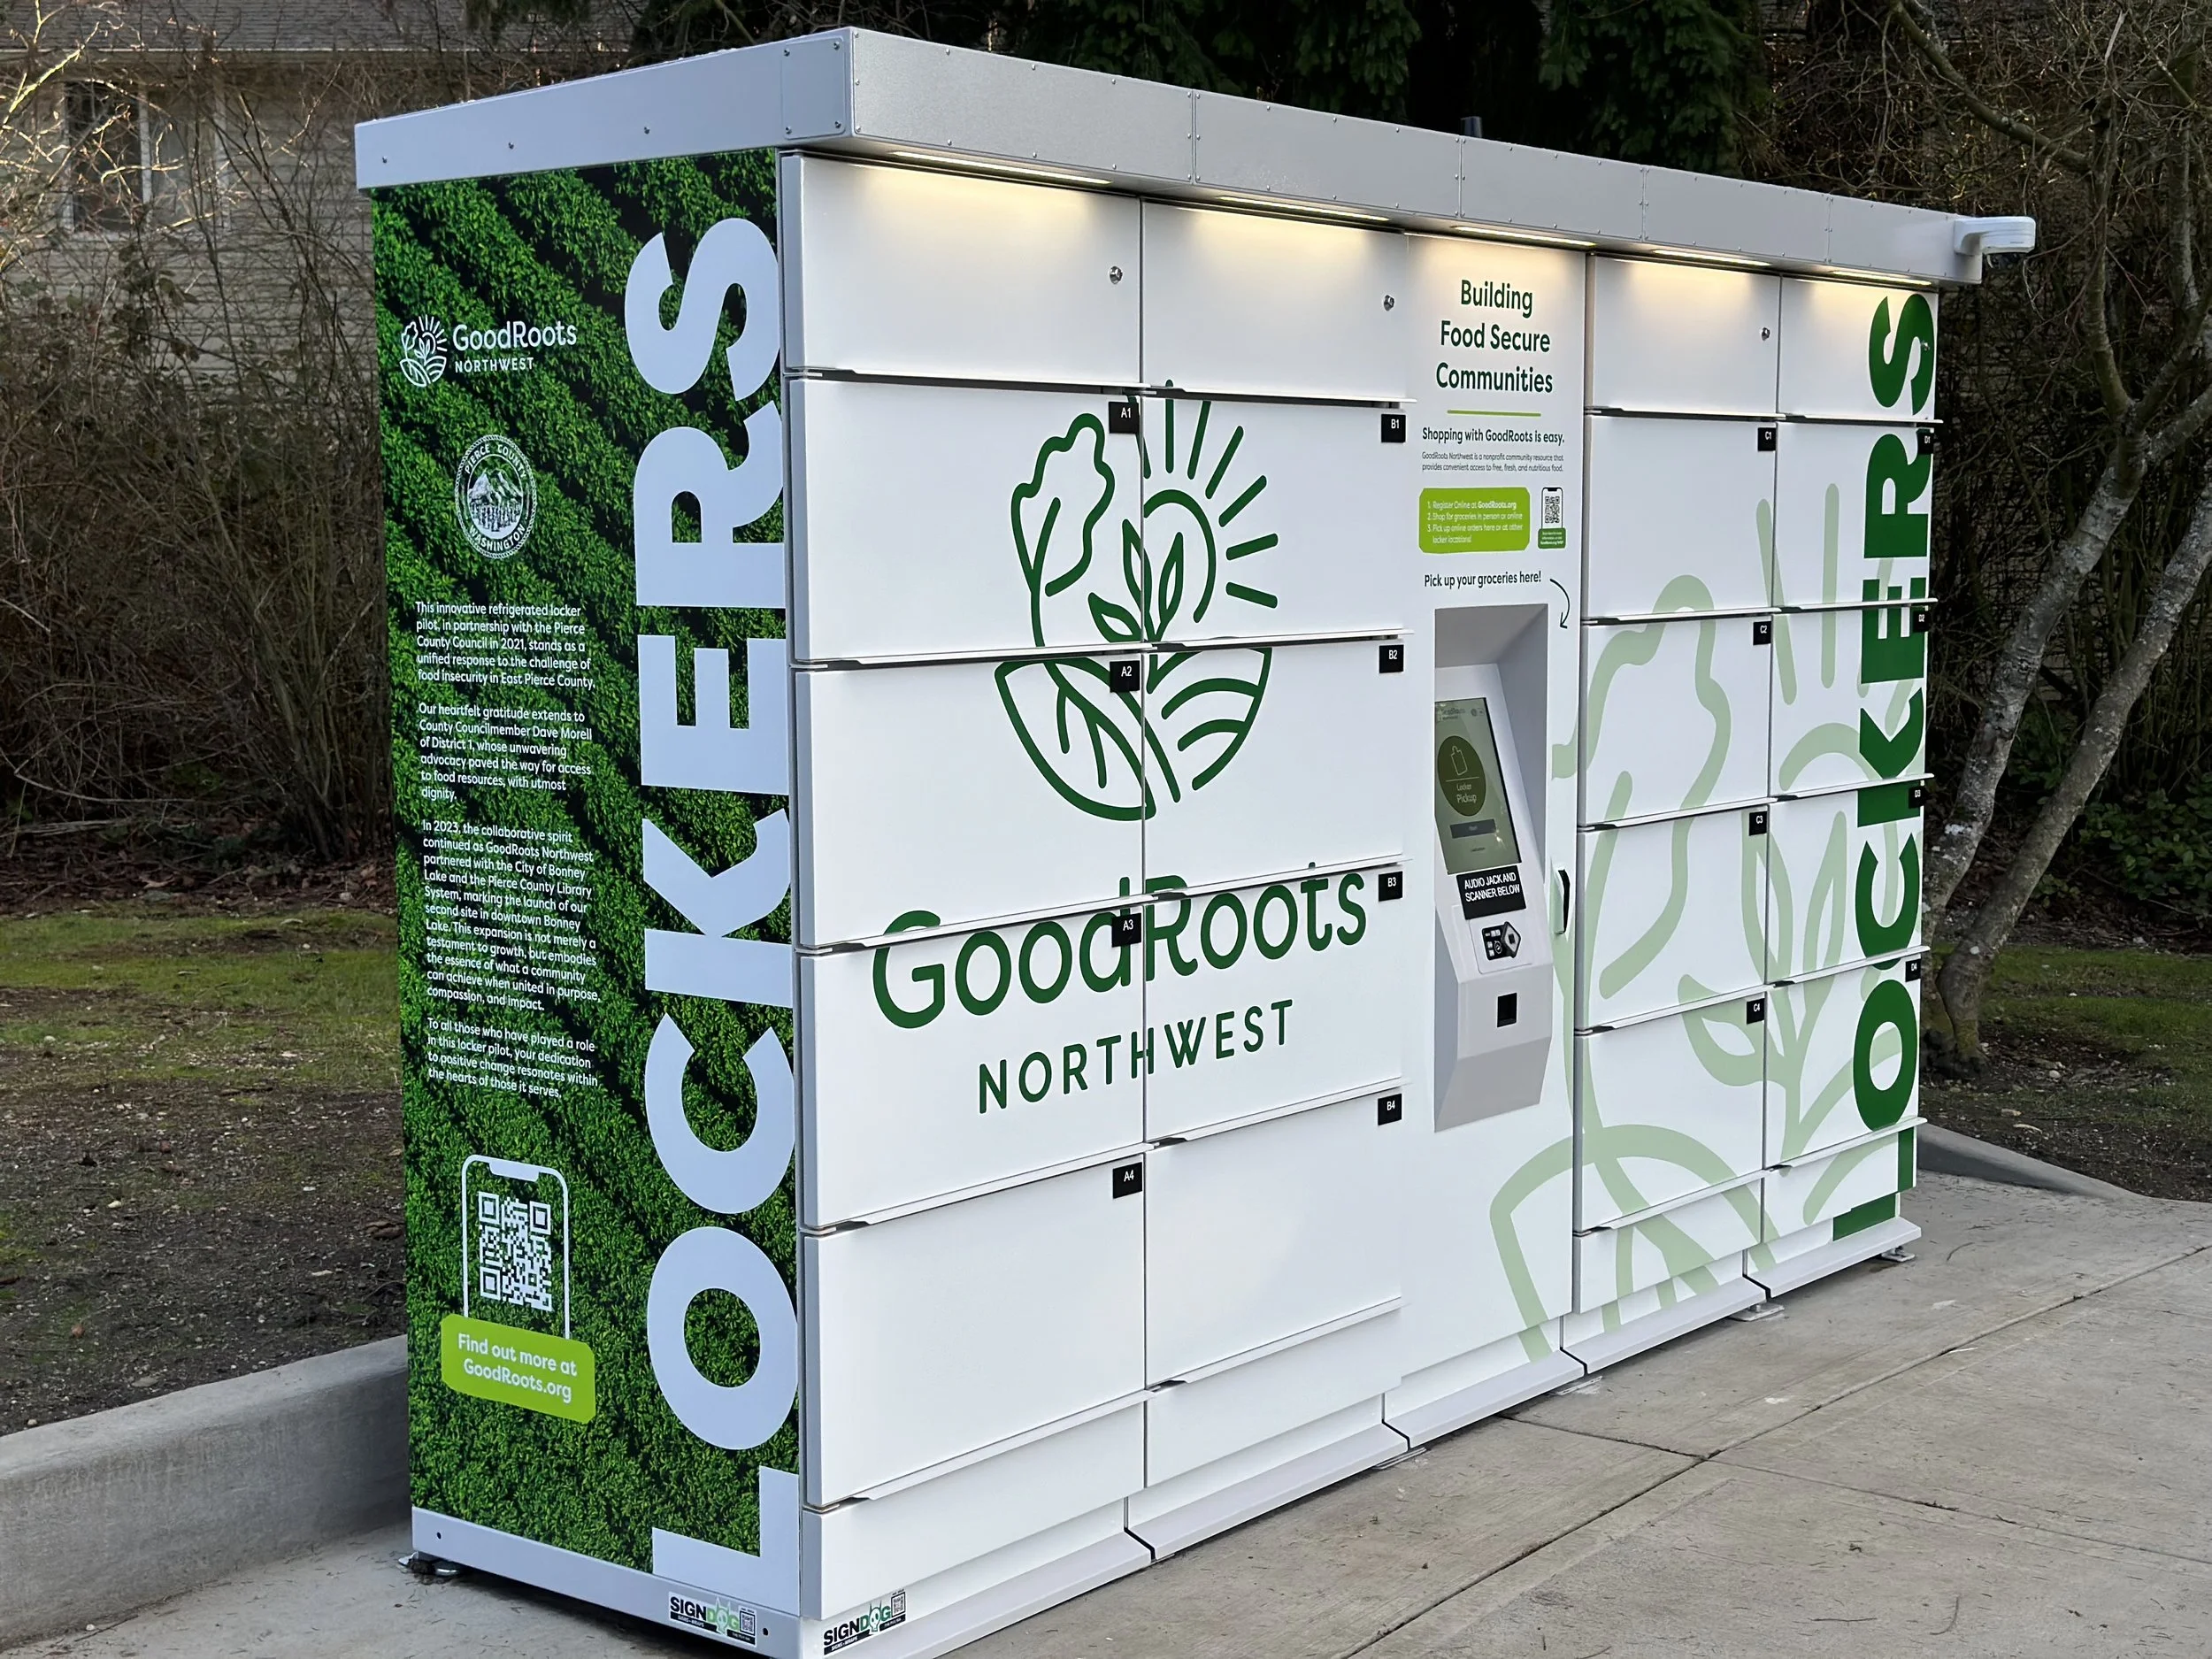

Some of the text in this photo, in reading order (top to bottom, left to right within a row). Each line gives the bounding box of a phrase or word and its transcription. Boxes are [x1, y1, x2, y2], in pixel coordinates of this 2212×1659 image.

[1461, 280, 1532, 318] Building
[453, 320, 577, 350] GoodRoots
[1441, 320, 1550, 352] Food Secure
[455, 357, 534, 373] NORTHWEST
[1437, 362, 1553, 393] Communities
[1121, 409, 1132, 418] A1
[1391, 419, 1399, 428] B1
[1423, 426, 1564, 446] Shopping with GoodRoots is easy.
[465, 444, 527, 478] PIERCE COUNTY
[469, 524, 526, 551] WASHINGTON
[1425, 571, 1541, 589] Pick up your groceries here!
[416, 602, 581, 618] This innovative refrigerated locker
[417, 620, 585, 634] pilot, in partnership with the Pierce
[1761, 625, 1767, 634] C2
[418, 635, 585, 652] County Council in 2021, stands as a
[418, 653, 592, 672] unified response to the challenge of
[1389, 650, 1397, 659] B2
[418, 670, 595, 690] food insecurity in East Pierce County.
[1121, 666, 1132, 677] A2
[419, 703, 585, 722] Our heartfelt gratitude extends to
[419, 719, 592, 740] County Councilmember Dave Morell
[420, 737, 567, 759] of District 1, whose unwavering
[421, 754, 591, 774] advocacy paved the way for access
[1833, 293, 1935, 1241] LOCKERS
[422, 771, 566, 790] to food resources, with utmost
[422, 787, 457, 802] dignity.
[1457, 793, 1477, 803] Pickup
[1388, 877, 1396, 887] B3
[1464, 872, 1516, 889] AUDIO JACK AND
[1465, 884, 1520, 902] SCANNER BELOW
[625, 218, 800, 1616] LOCKERS
[1123, 919, 1133, 931] A3
[872, 863, 1366, 1028] GoodRoots
[427, 1018, 438, 1029] To
[441, 1021, 452, 1030] all
[454, 1021, 480, 1034] those
[483, 1026, 503, 1038] who
[504, 1028, 528, 1041] have
[531, 1033, 565, 1048] played
[576, 1040, 595, 1051] role
[428, 1034, 591, 1068] in this locker pilot, your dedication
[979, 999, 1293, 1113] NORTHWEST
[428, 1051, 597, 1087] to positive change resonates within
[428, 1068, 561, 1098] the hearts of those it serves.
[1387, 1101, 1395, 1110] B4
[1124, 1170, 1134, 1181] A4
[458, 1333, 577, 1376] Find out more at
[464, 1358, 572, 1403] GoodRoots.org
